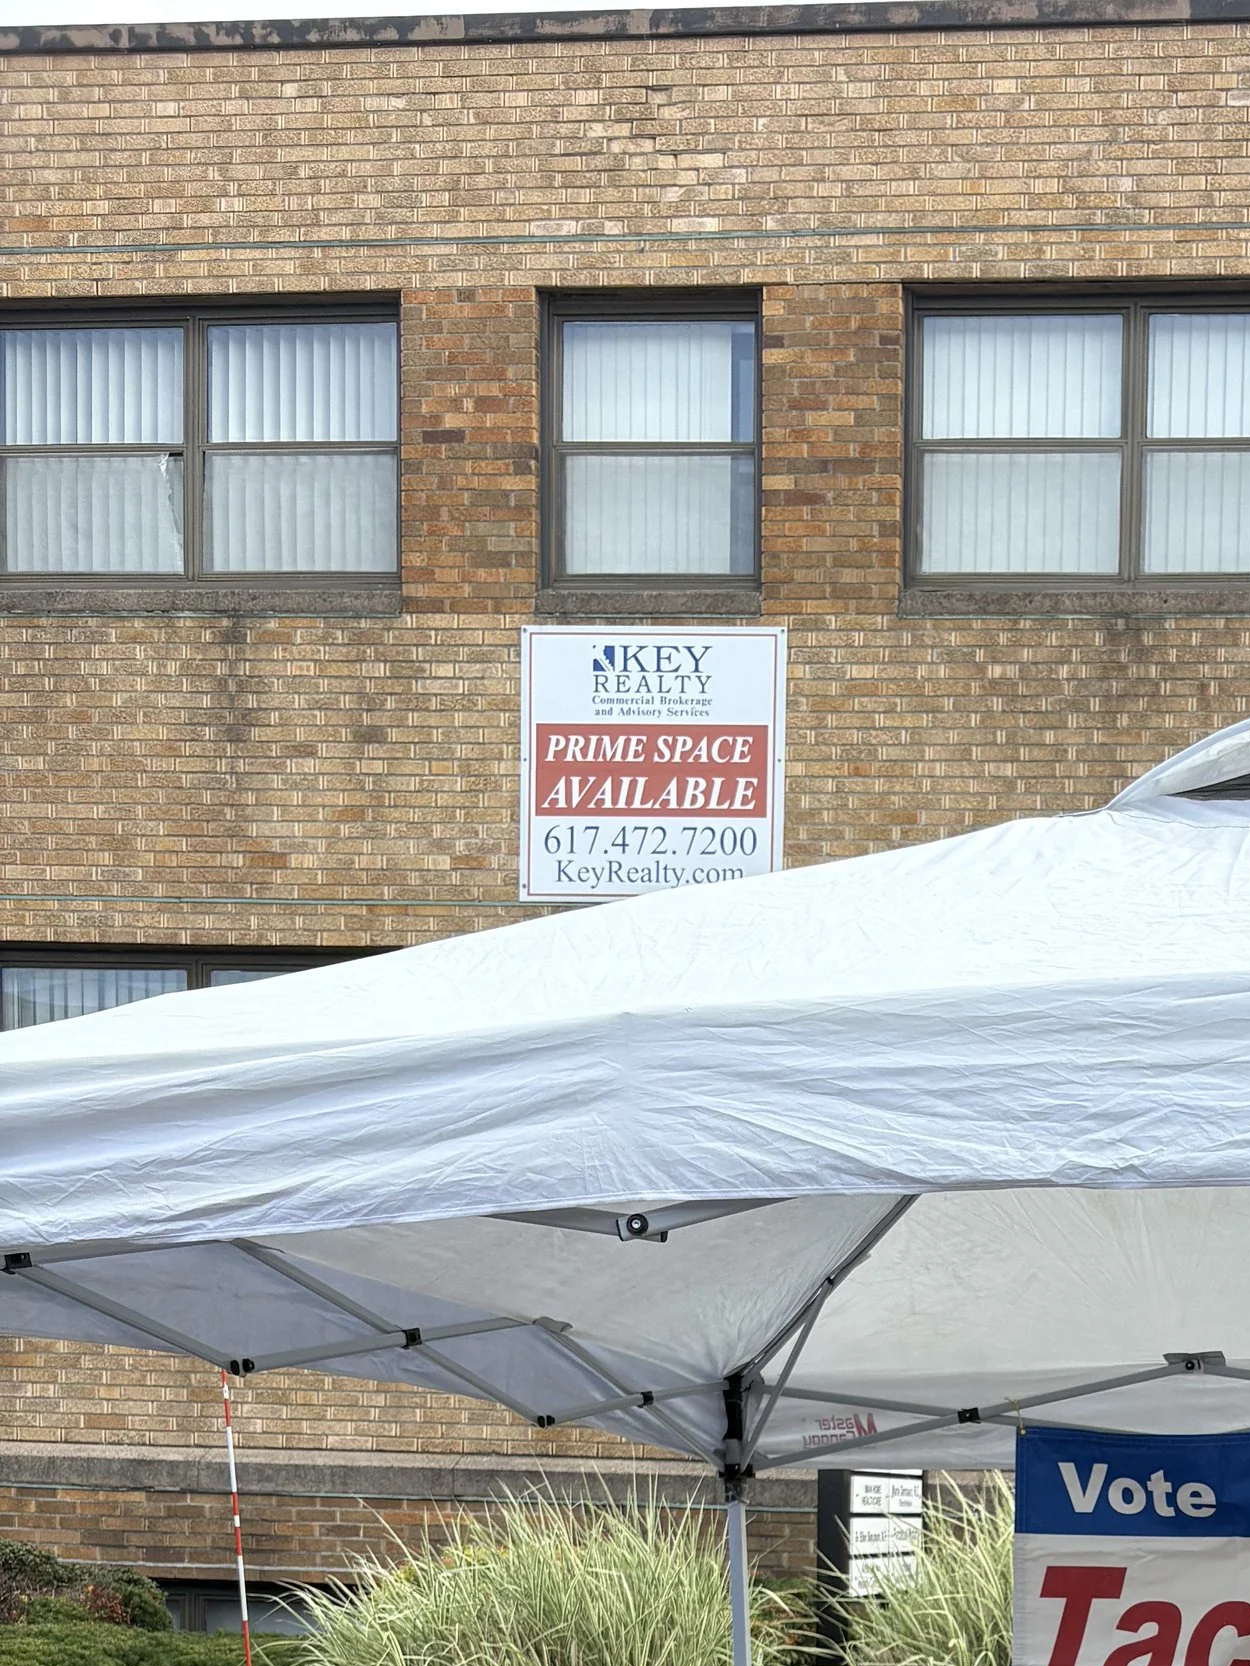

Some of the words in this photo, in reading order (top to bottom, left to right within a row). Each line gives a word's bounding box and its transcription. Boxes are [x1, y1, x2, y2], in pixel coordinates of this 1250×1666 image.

[619, 645, 713, 673] KEY
[593, 675, 712, 694] REALTY
[592, 695, 654, 706] Commercial
[660, 696, 712, 707] Brokerage
[595, 707, 612, 717] and
[618, 707, 662, 718] Advisory
[667, 707, 709, 718] Services
[545, 735, 647, 762] PRIME
[653, 736, 753, 763] SPACE
[541, 775, 758, 810] AVAILABLE
[544, 825, 757, 856] 617.472.7200
[557, 860, 743, 888] KeyRealty.com
[1058, 1462, 1217, 1518] Vote
